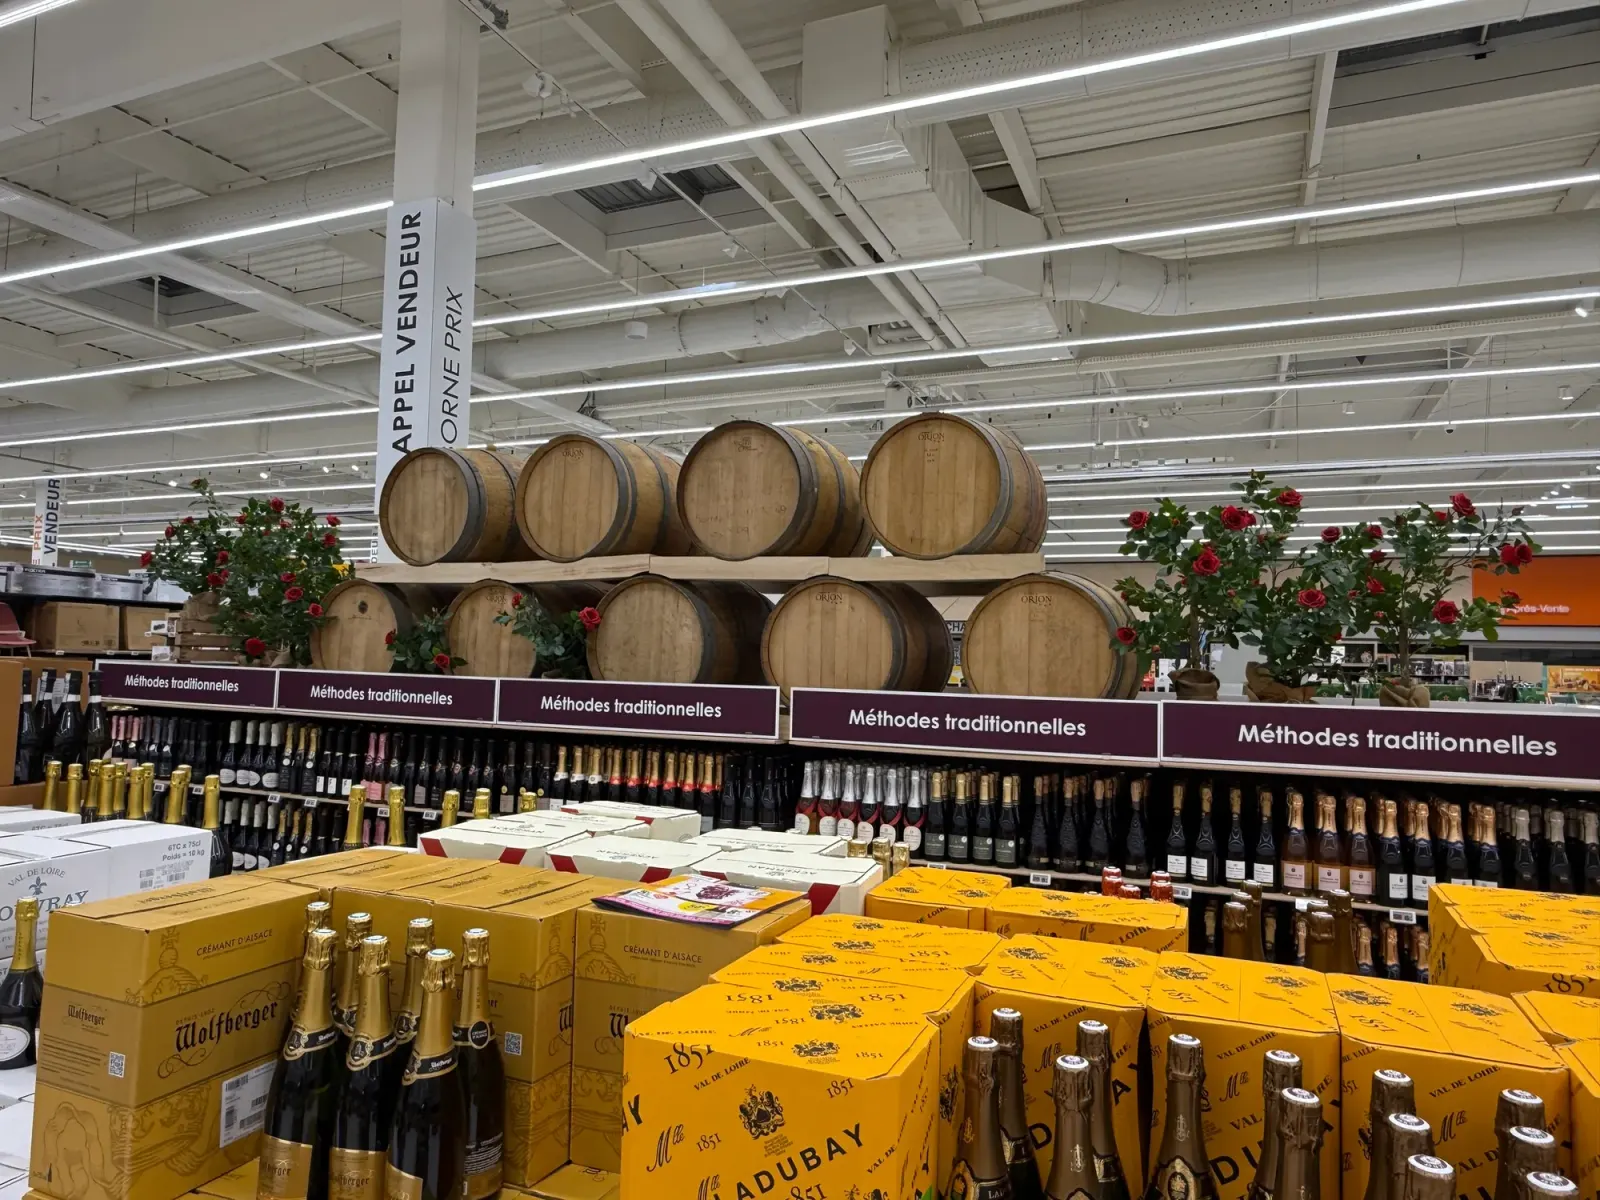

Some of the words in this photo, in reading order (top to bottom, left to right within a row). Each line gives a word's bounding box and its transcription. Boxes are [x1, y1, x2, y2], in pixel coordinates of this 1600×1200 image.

[396, 211, 421, 355] VENDEUR
[444, 286, 463, 351] PRIX
[392, 363, 415, 454] APPEL
[440, 357, 460, 448] ORNE
[918, 431, 945, 442] ORION
[43, 478, 61, 554] VENDEUR
[815, 591, 843, 603] ORION
[1021, 594, 1052, 606] ORION
[125, 674, 169, 689] Méthodes
[171, 677, 239, 693] traditionnelles
[310, 685, 365, 701] Méthodes
[367, 688, 453, 705] traditionnelles
[541, 695, 610, 713] Méthodes
[614, 698, 722, 718] traditionnelles
[849, 708, 940, 730] Méthodes
[945, 713, 1086, 736] traditionnelles
[1238, 723, 1359, 748] Méthodes
[1367, 729, 1557, 756] traditionnelles
[162, 852, 181, 861] Poids
[8, 873, 26, 887] VAL
[27, 868, 39, 877] DE
[41, 867, 66, 878] LOIRE
[196, 938, 236, 957] CRÉMANT
[238, 928, 273, 946] D'ALSACE
[623, 944, 661, 957] CRÉMANT
[663, 951, 703, 963] D'ALSACE
[859, 992, 907, 1003] 1851
[68, 1005, 106, 1026] Wolfberger
[176, 1002, 278, 1052] Wolfberger
[1033, 1022, 1049, 1033] VAL
[1050, 1017, 1062, 1027] DE
[1063, 1005, 1089, 1021] LOIRE
[756, 1040, 785, 1048] 1851
[855, 1051, 884, 1059] 1851
[1216, 1049, 1234, 1060] VAL
[1235, 1043, 1248, 1053] DE
[1249, 1032, 1278, 1047] LOIRE
[664, 1041, 715, 1074] 1851
[694, 1079, 711, 1091] VAL
[711, 1071, 723, 1082] DE
[724, 1056, 751, 1075] LOIRE
[1429, 1086, 1451, 1098] VAL
[1451, 1078, 1466, 1090] DE
[1467, 1065, 1501, 1082] LOIRE
[826, 1078, 855, 1098] 1851
[1230, 1113, 1263, 1131] VAL
[696, 1133, 722, 1151] 1851
[867, 1157, 884, 1174] VAL
[883, 1144, 898, 1158] DE
